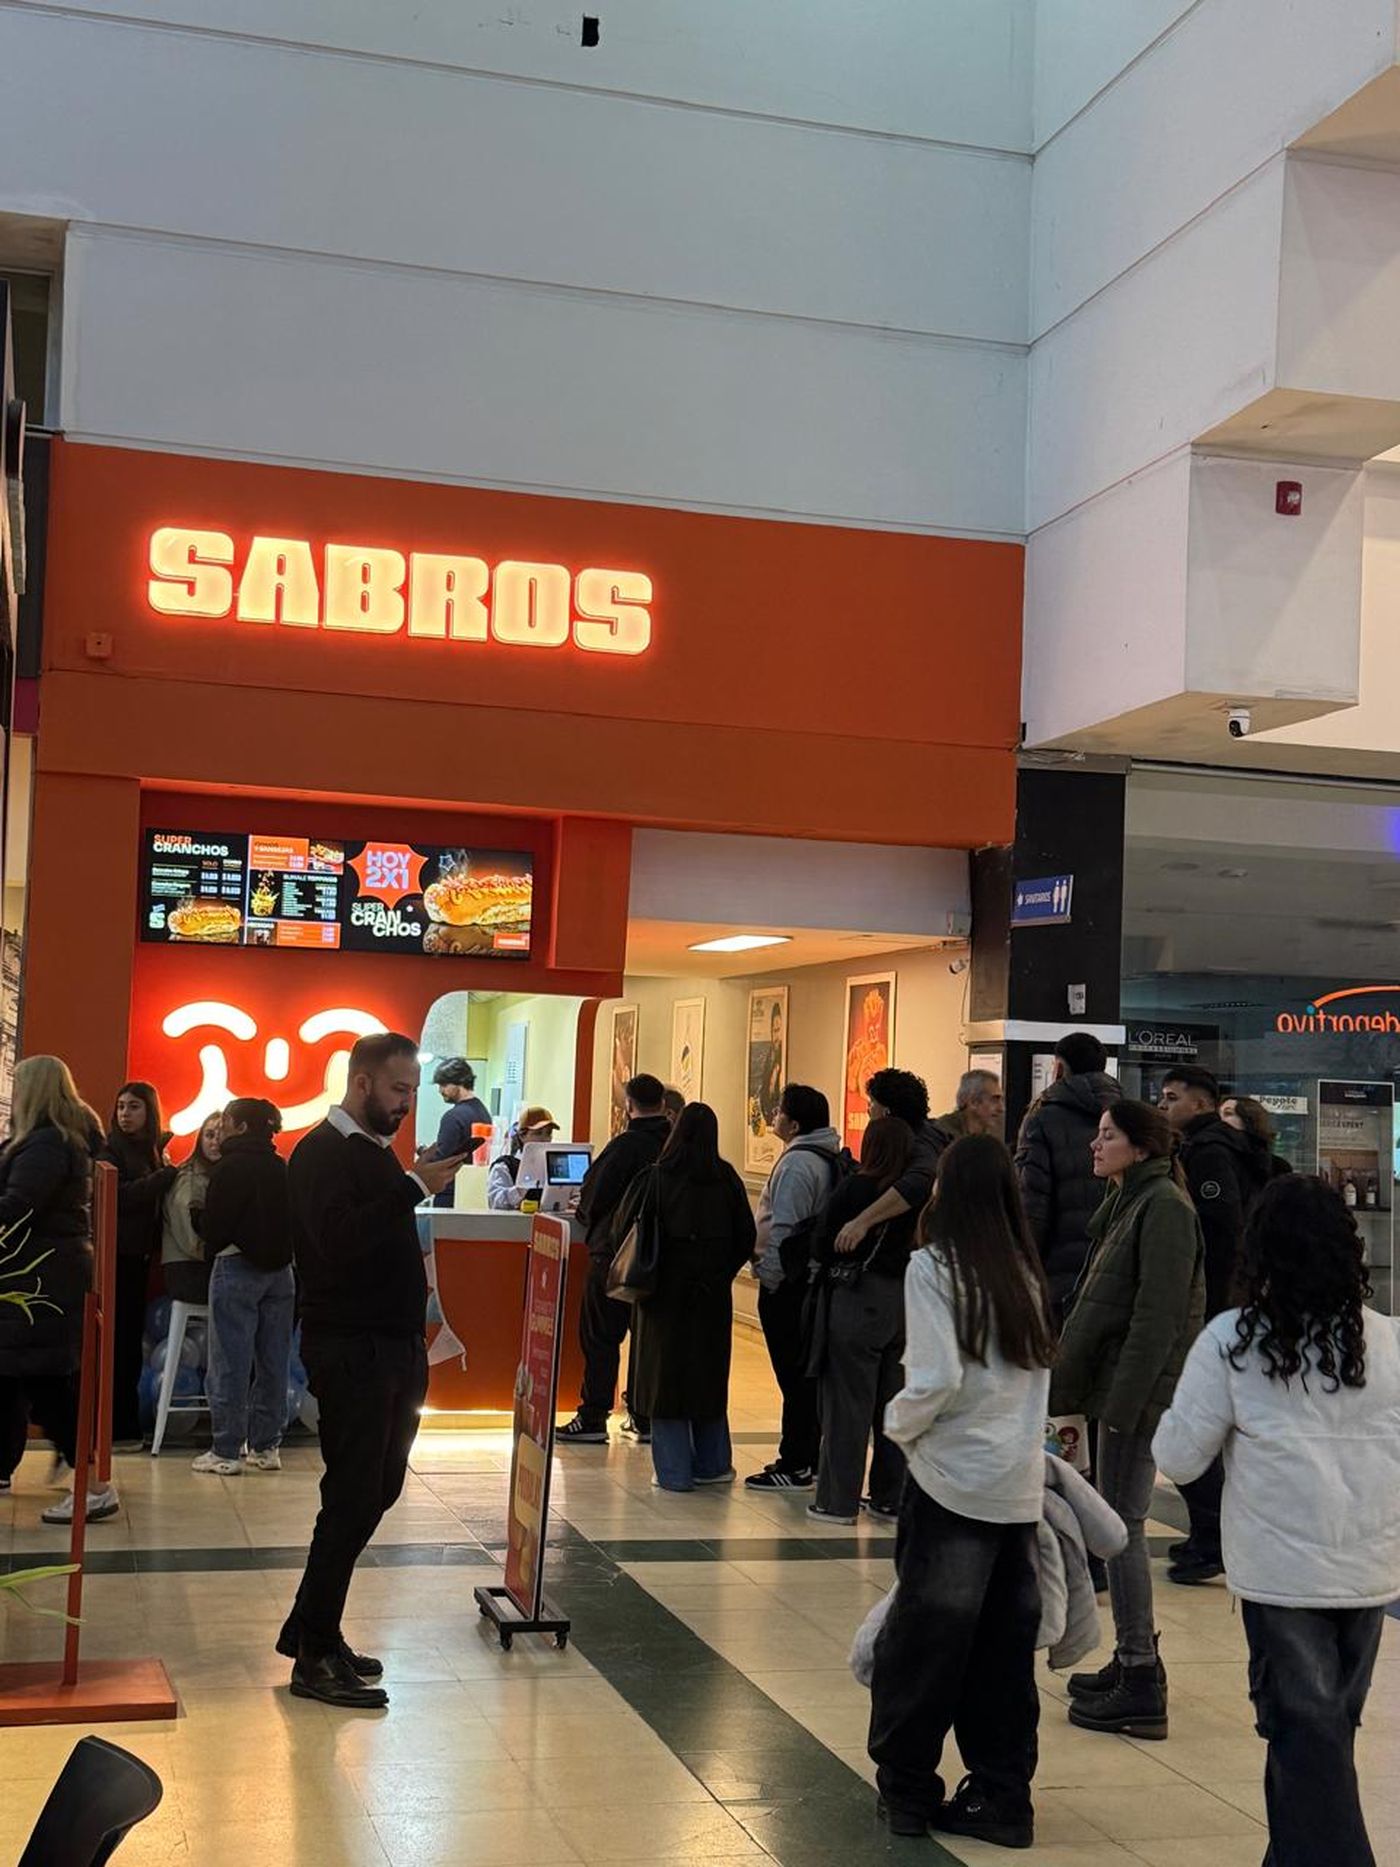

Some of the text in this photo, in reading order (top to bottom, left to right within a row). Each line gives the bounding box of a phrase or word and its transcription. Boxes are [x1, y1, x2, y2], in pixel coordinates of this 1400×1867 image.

[148, 526, 653, 655] SABROS
[154, 834, 192, 844] SUPER
[153, 842, 229, 856] CRANCHOS
[366, 851, 410, 867] HOY
[365, 867, 409, 889] 2X1
[352, 903, 384, 912] SUPER
[351, 910, 400, 926] CRAN
[372, 922, 421, 937] CHOS
